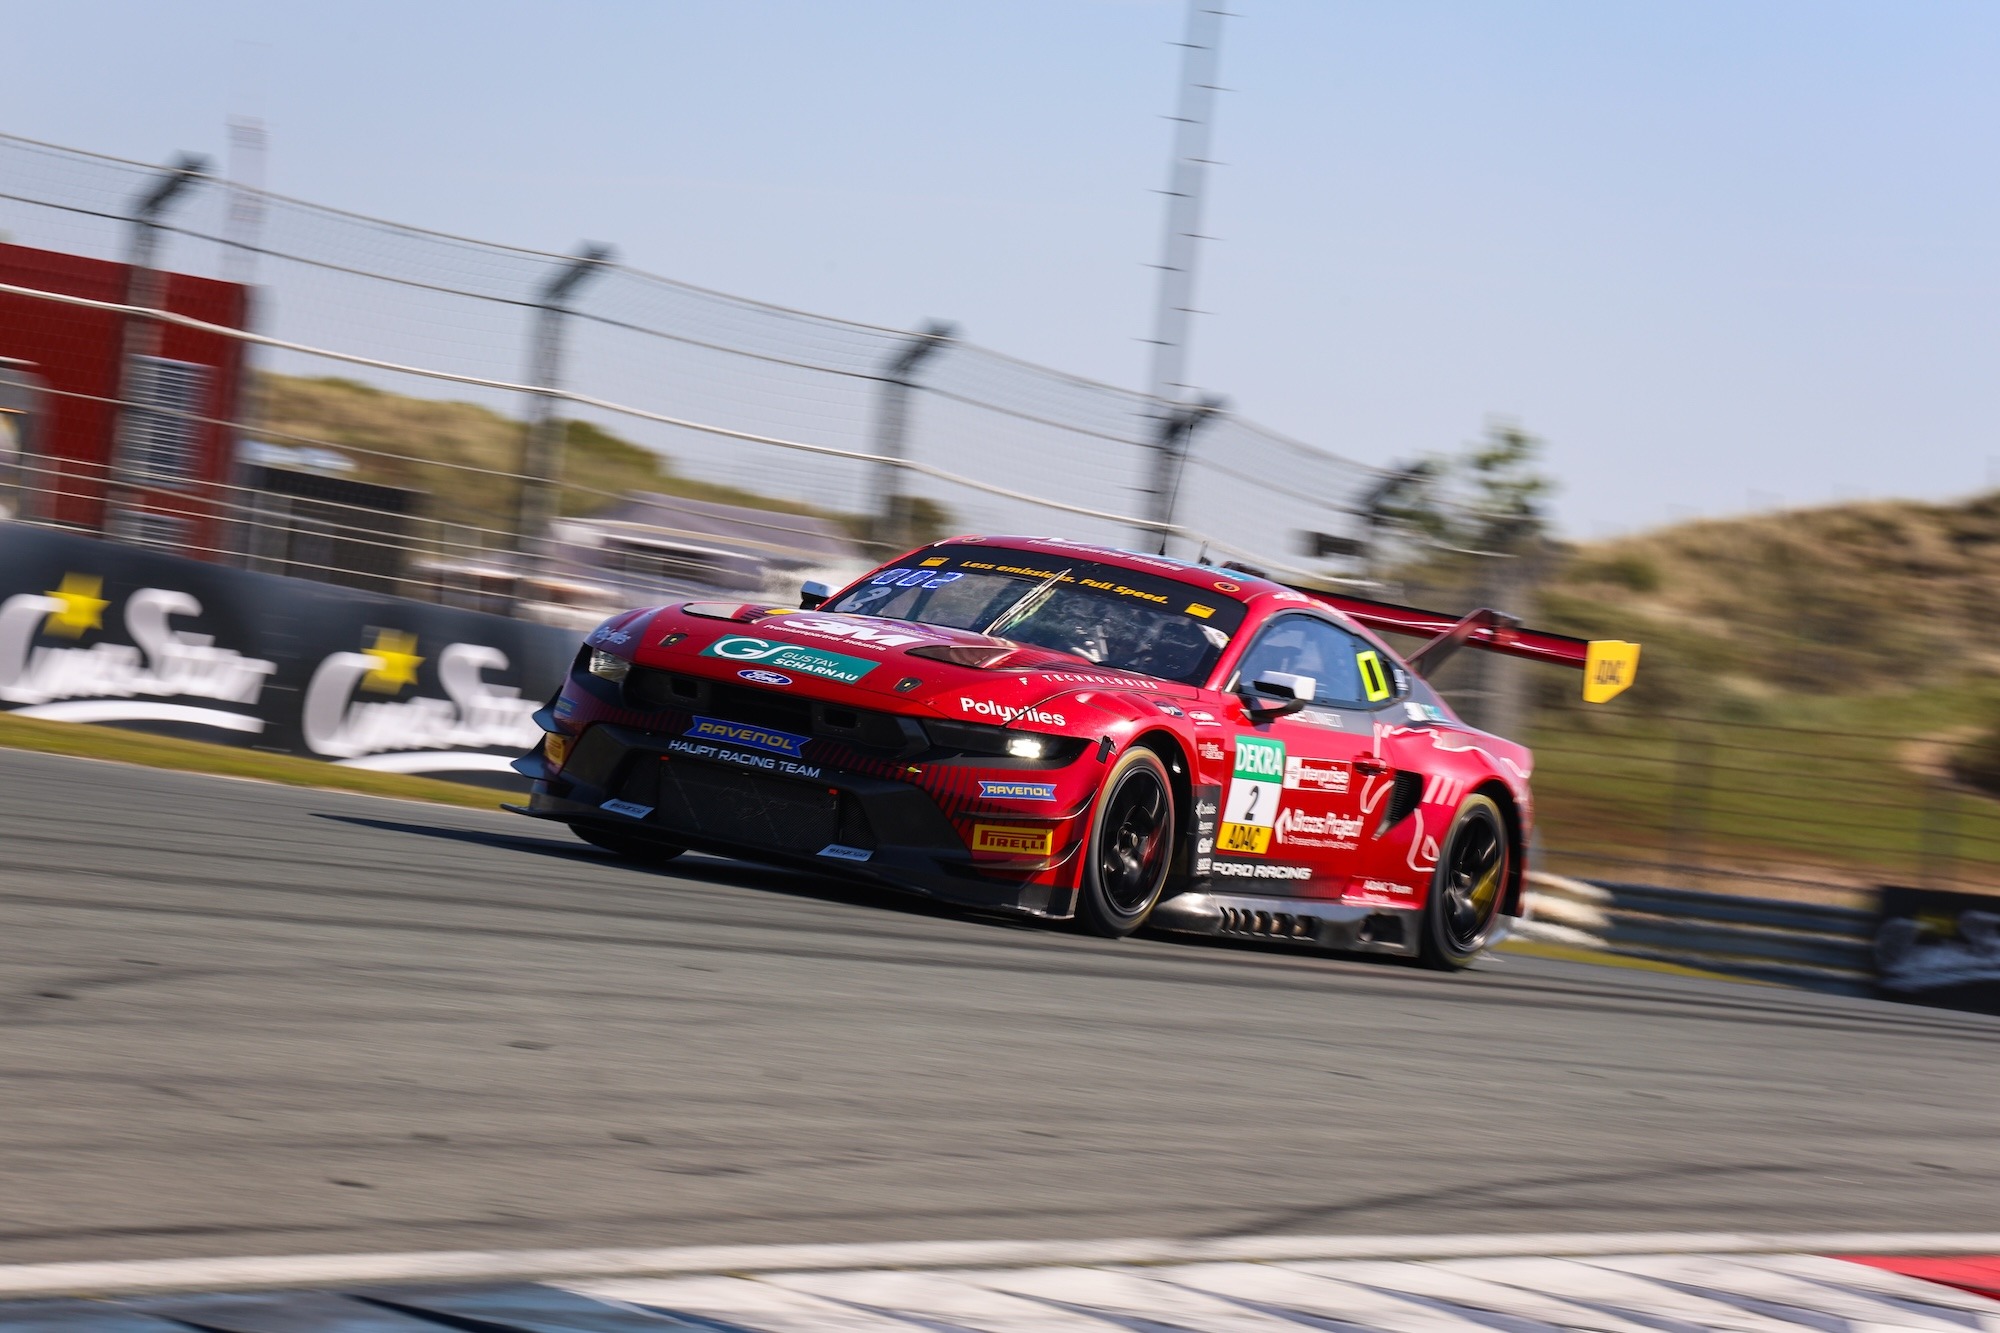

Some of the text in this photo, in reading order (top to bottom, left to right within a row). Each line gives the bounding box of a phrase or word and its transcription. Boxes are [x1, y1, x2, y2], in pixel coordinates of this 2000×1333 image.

[960, 560, 1168, 604] Less emissios. Full Speed.
[843, 638, 887, 651] Industrie
[773, 658, 859, 681] SCHARNAU
[781, 652, 838, 667] GUSTAV
[746, 671, 784, 682] Ford
[960, 697, 1066, 726] Polyvlies
[697, 723, 796, 750] RAVENOL
[668, 740, 821, 778] HAUPT RACING TEAM
[1236, 743, 1283, 775] DEKRA
[986, 785, 1050, 796] RAVENOL
[1244, 785, 1259, 820] 2
[980, 830, 1046, 849] PIRELLI
[1227, 825, 1261, 850] ADAC
[1254, 865, 1312, 880] RACING
